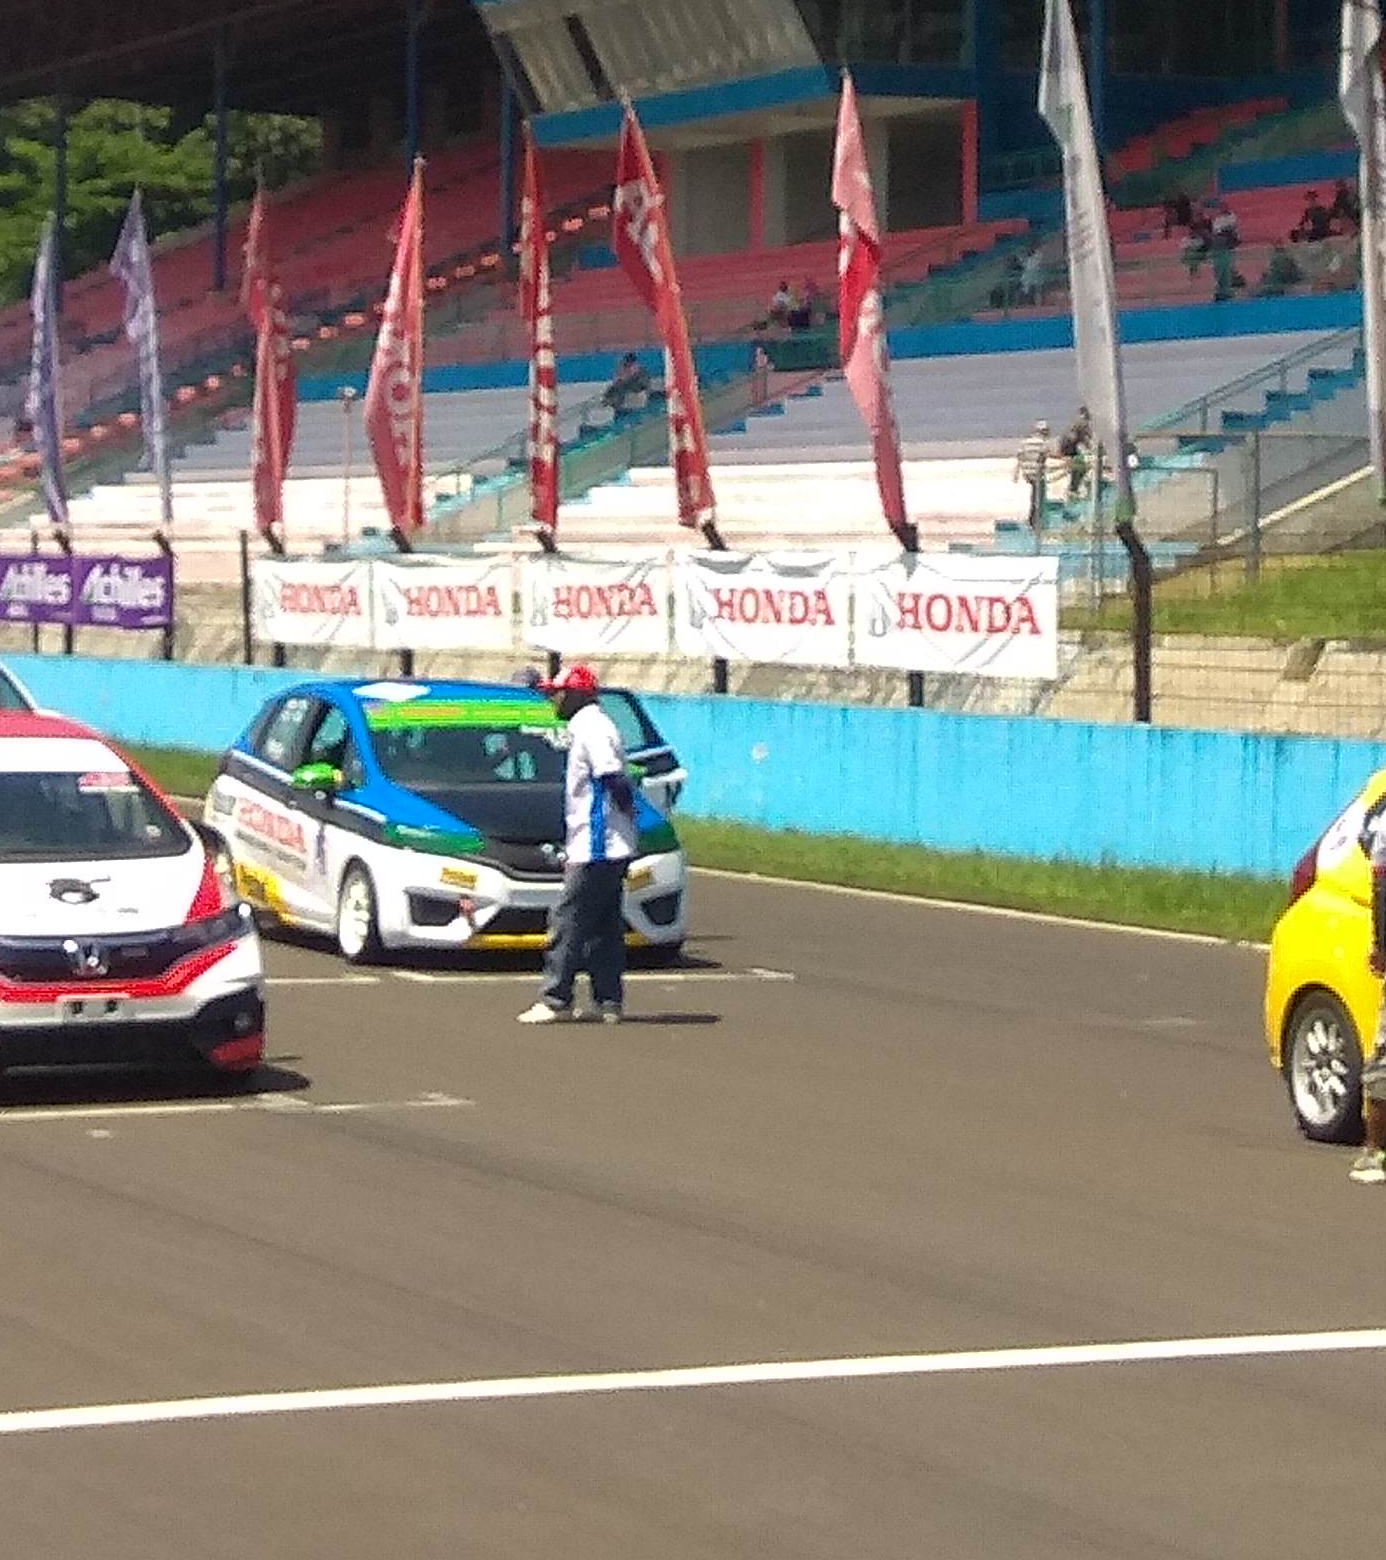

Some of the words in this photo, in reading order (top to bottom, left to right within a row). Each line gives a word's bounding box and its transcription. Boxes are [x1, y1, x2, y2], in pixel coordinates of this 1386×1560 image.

[404, 585, 502, 617] HONDA
[552, 583, 658, 618] HONDA
[713, 587, 836, 626] HONDA
[896, 591, 1042, 635] HONDA
